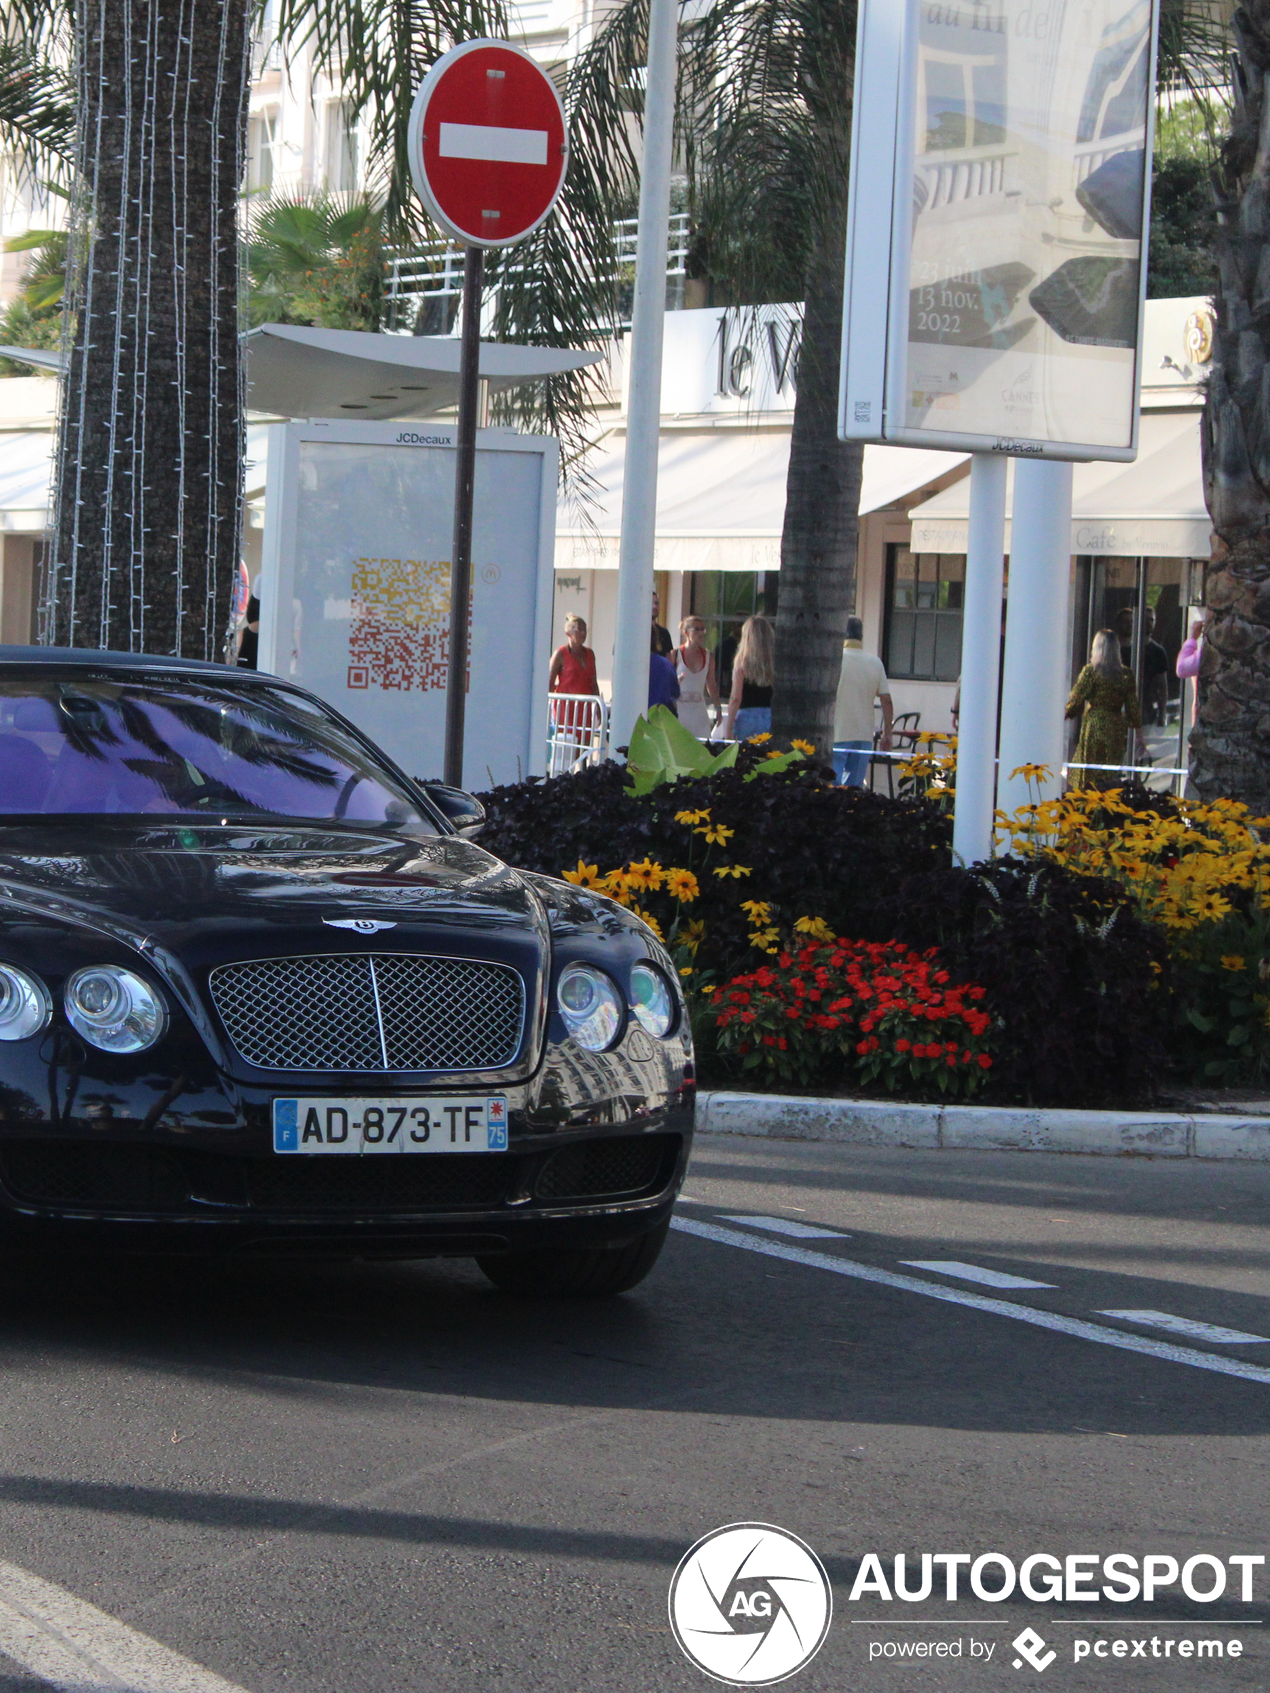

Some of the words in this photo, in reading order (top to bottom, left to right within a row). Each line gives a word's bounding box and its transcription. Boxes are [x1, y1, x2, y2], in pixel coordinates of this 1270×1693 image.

[917, 286, 936, 311] 13
[940, 291, 979, 311] nov.
[917, 311, 962, 333] 2022
[395, 432, 451, 445] JCDecaux
[991, 436, 1045, 453] JCDecaux
[282, 1130, 290, 1142] F
[301, 1106, 484, 1144] AD-873-TF
[488, 1125, 506, 1145] 75
